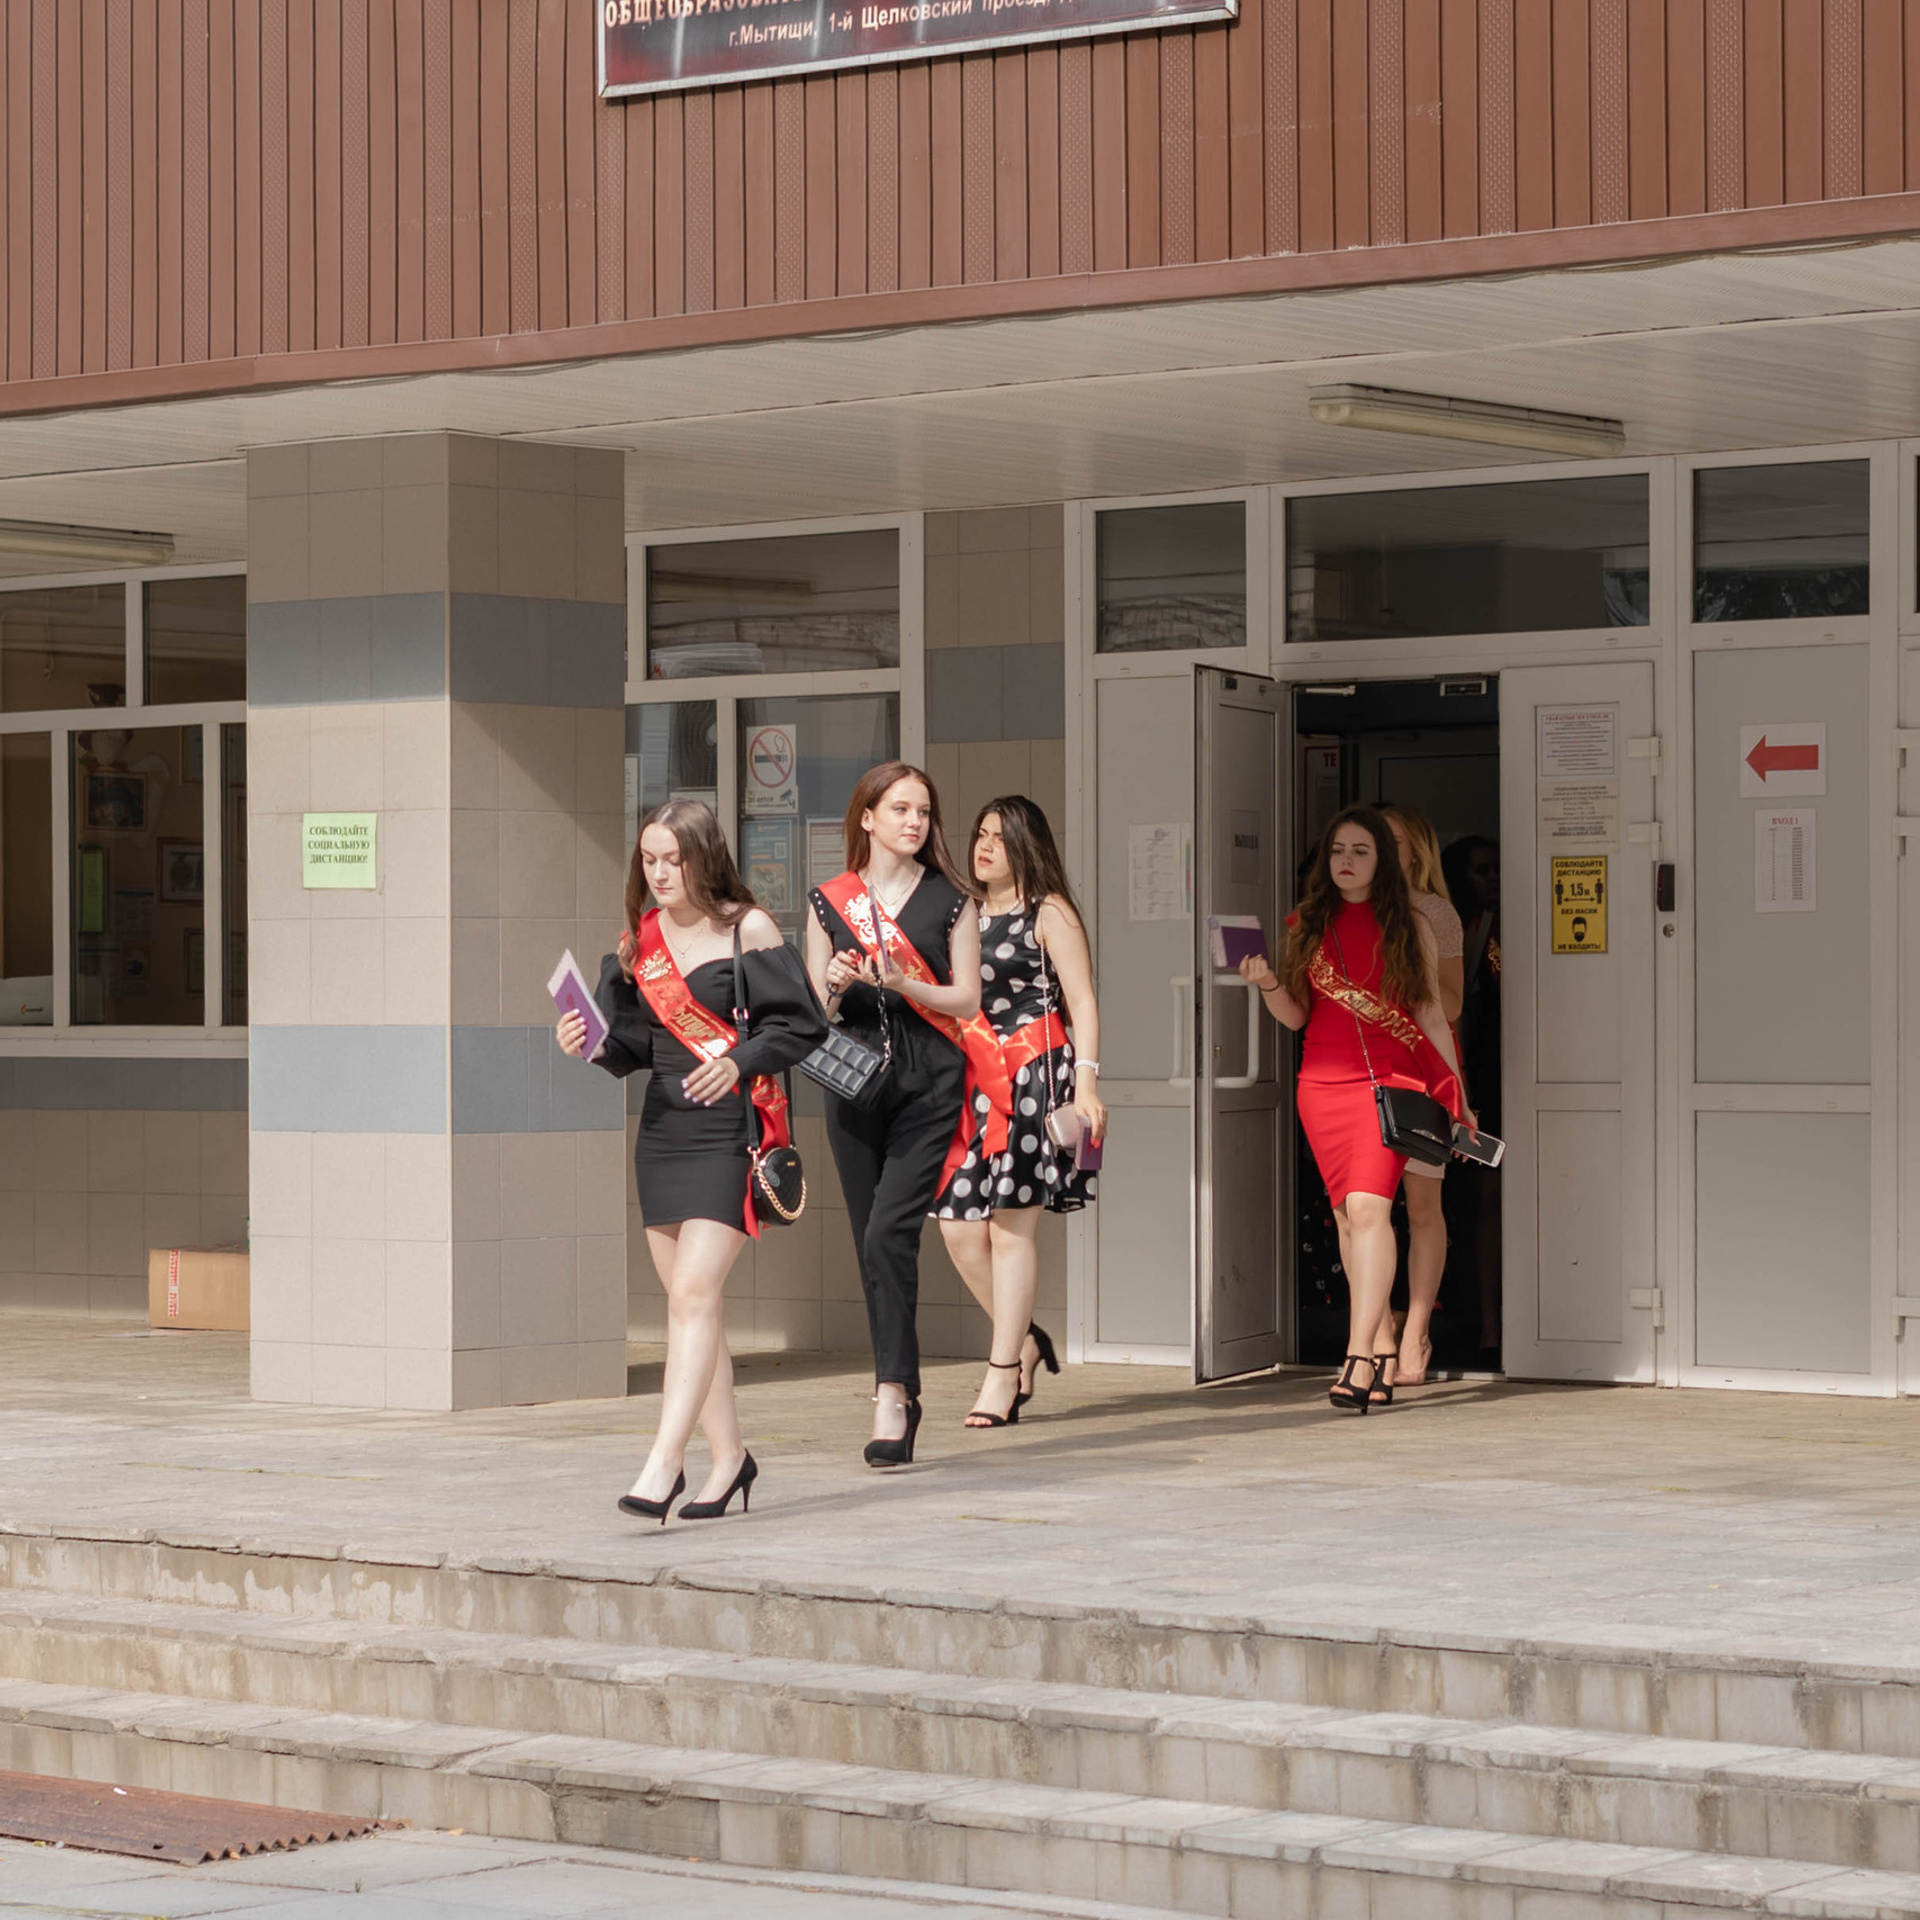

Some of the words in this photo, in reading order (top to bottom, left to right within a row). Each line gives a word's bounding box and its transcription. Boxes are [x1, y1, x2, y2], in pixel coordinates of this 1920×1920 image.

[729, 22, 818, 48] г.Мытищи,
[828, 11, 852, 33] 1-й
[861, 0, 972, 30] Щелковский
[310, 825, 368, 836] СОБЛЮДАЙТЕ
[308, 840, 370, 850] СОЦИАЛЬНУЮ
[1555, 860, 1603, 868] СОБЛЮДАЙТЕ
[1556, 869, 1602, 877] ДИСТАНЦИЮ
[1379, 1010, 1423, 1053] 2021
